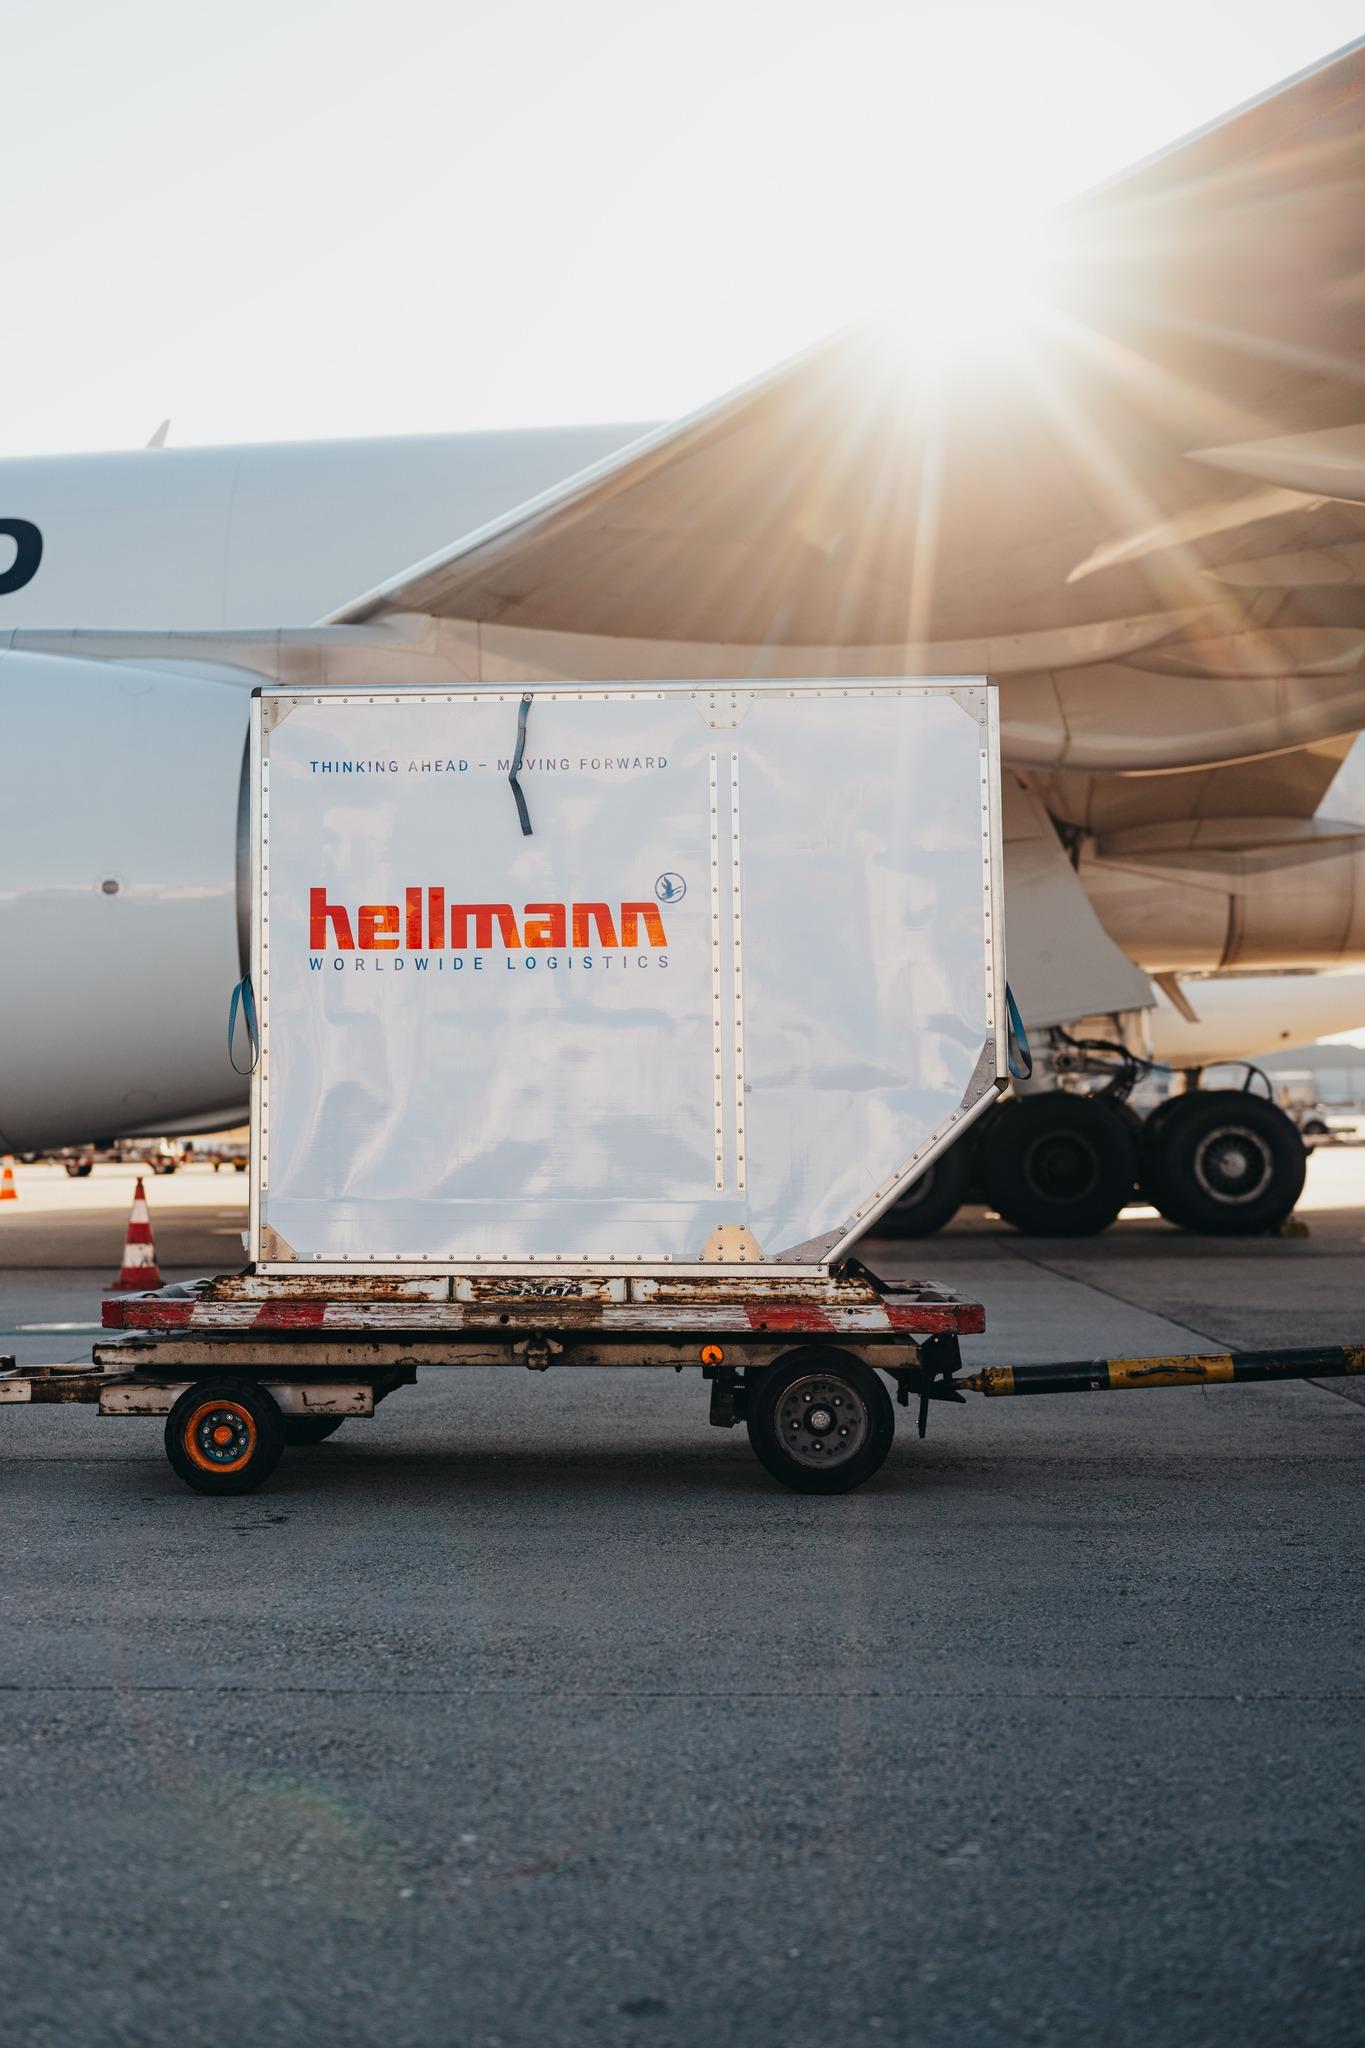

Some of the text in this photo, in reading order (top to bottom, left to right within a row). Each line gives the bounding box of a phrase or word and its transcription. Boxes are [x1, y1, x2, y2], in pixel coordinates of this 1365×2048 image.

[310, 760, 399, 774] THINKING
[408, 760, 469, 773] AHEAD
[579, 756, 668, 771] FORWARD
[309, 887, 668, 950] hellmann
[309, 955, 670, 971] WORLDWIDE LOGISTICS
